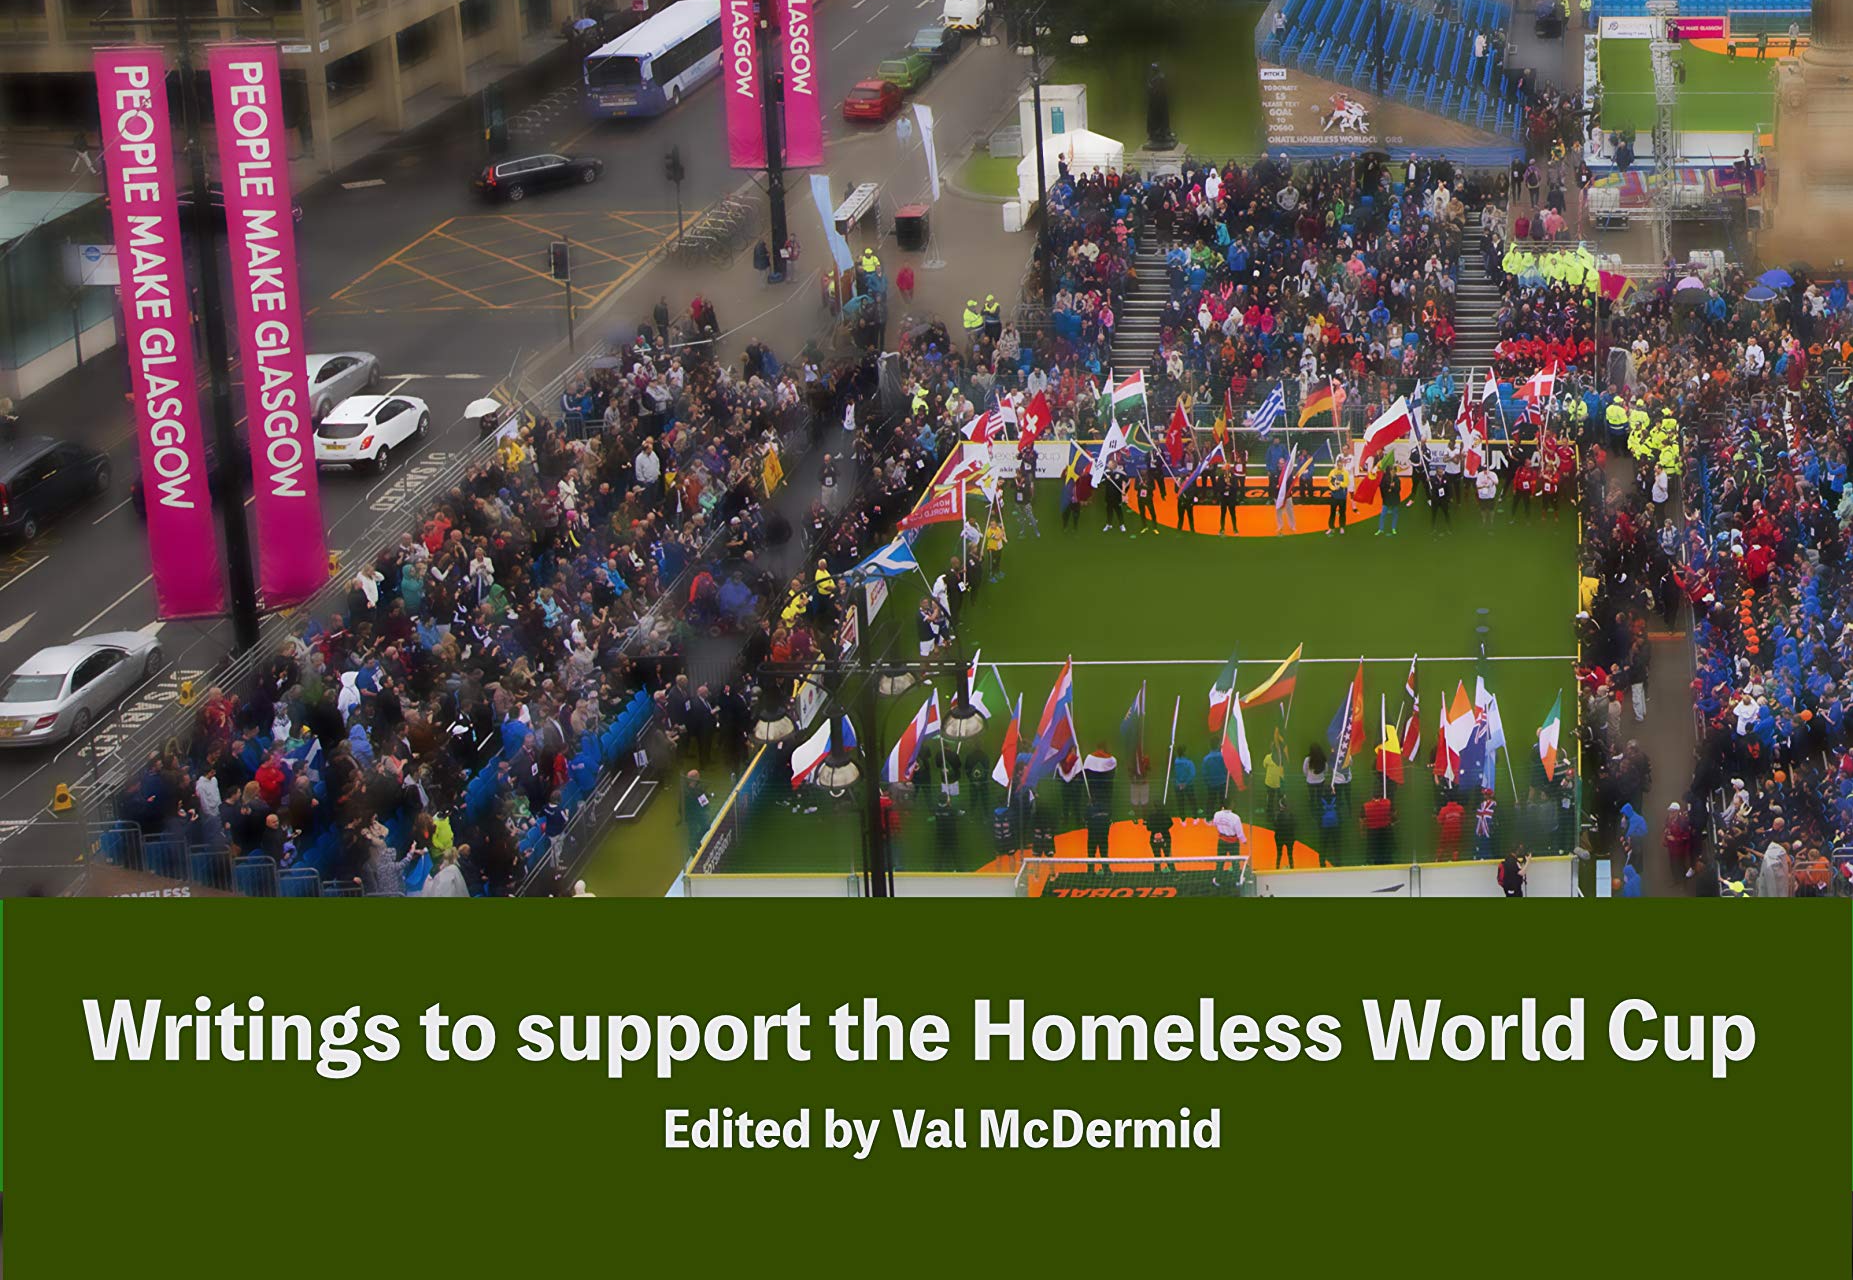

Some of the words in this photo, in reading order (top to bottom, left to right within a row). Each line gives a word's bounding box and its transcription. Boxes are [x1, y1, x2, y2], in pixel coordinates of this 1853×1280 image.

[114, 65, 160, 203] PEOPLE
[228, 61, 275, 197] PEOPLE
[1269, 108, 1293, 116] GOAL
[127, 215, 172, 320] MAKE
[242, 209, 286, 312] MAKE
[139, 327, 194, 508] GLASGOW
[254, 320, 306, 497] GLASGOW
